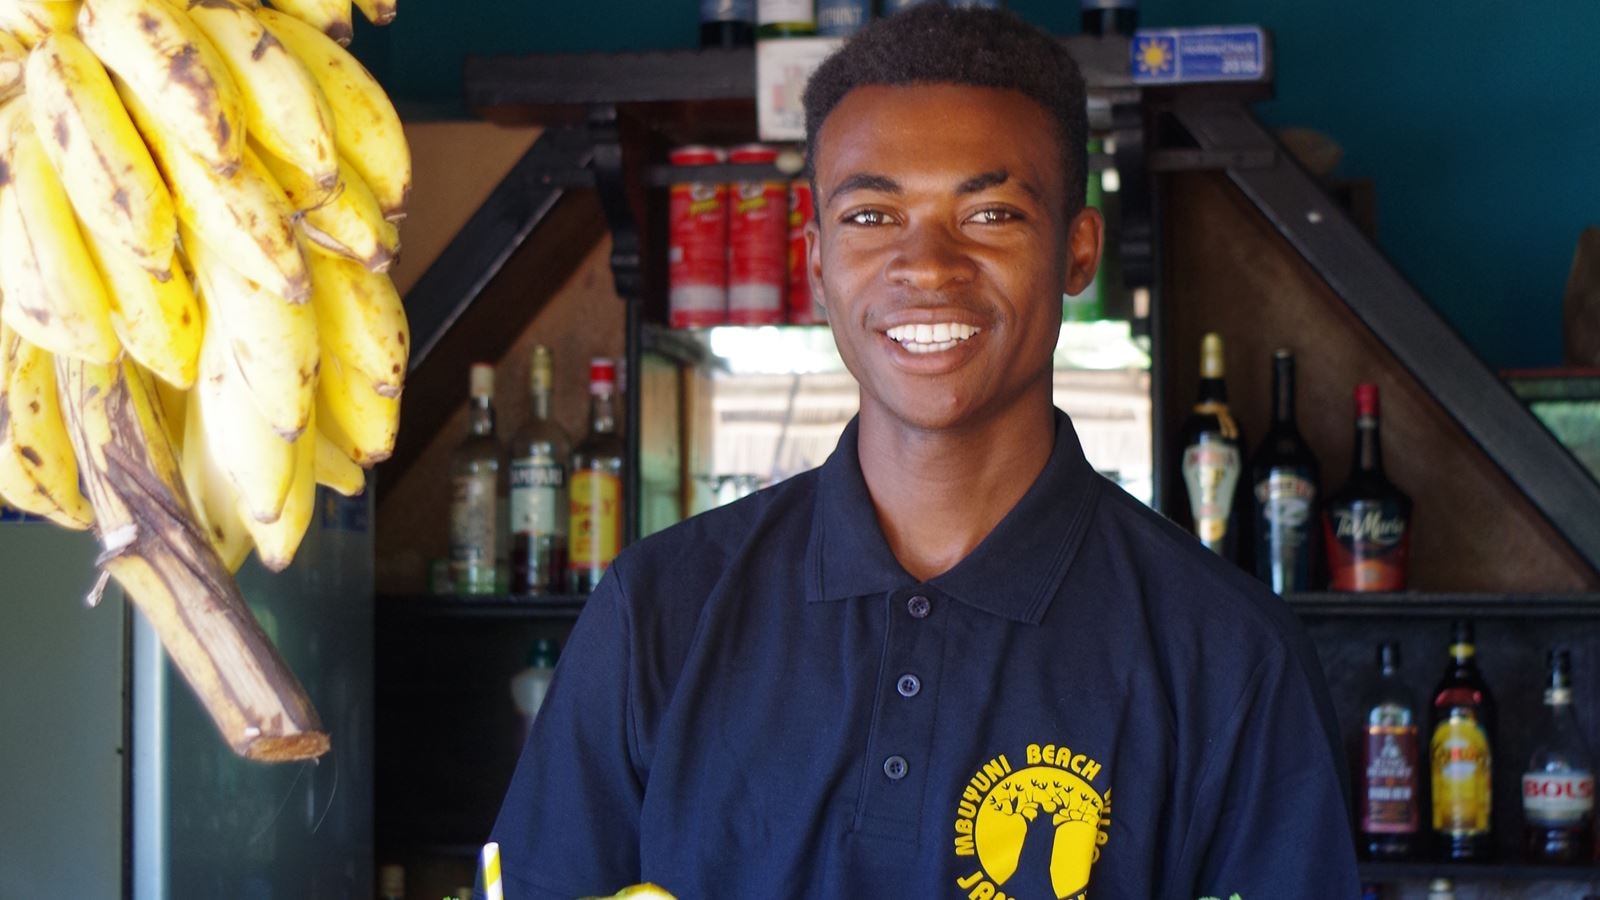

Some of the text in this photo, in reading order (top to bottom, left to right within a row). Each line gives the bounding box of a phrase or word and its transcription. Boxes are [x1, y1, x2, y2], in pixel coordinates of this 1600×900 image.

[954, 754, 1012, 856] MBUYUNI
[1026, 743, 1102, 781] BEACH
[1524, 779, 1593, 798] BOLS
